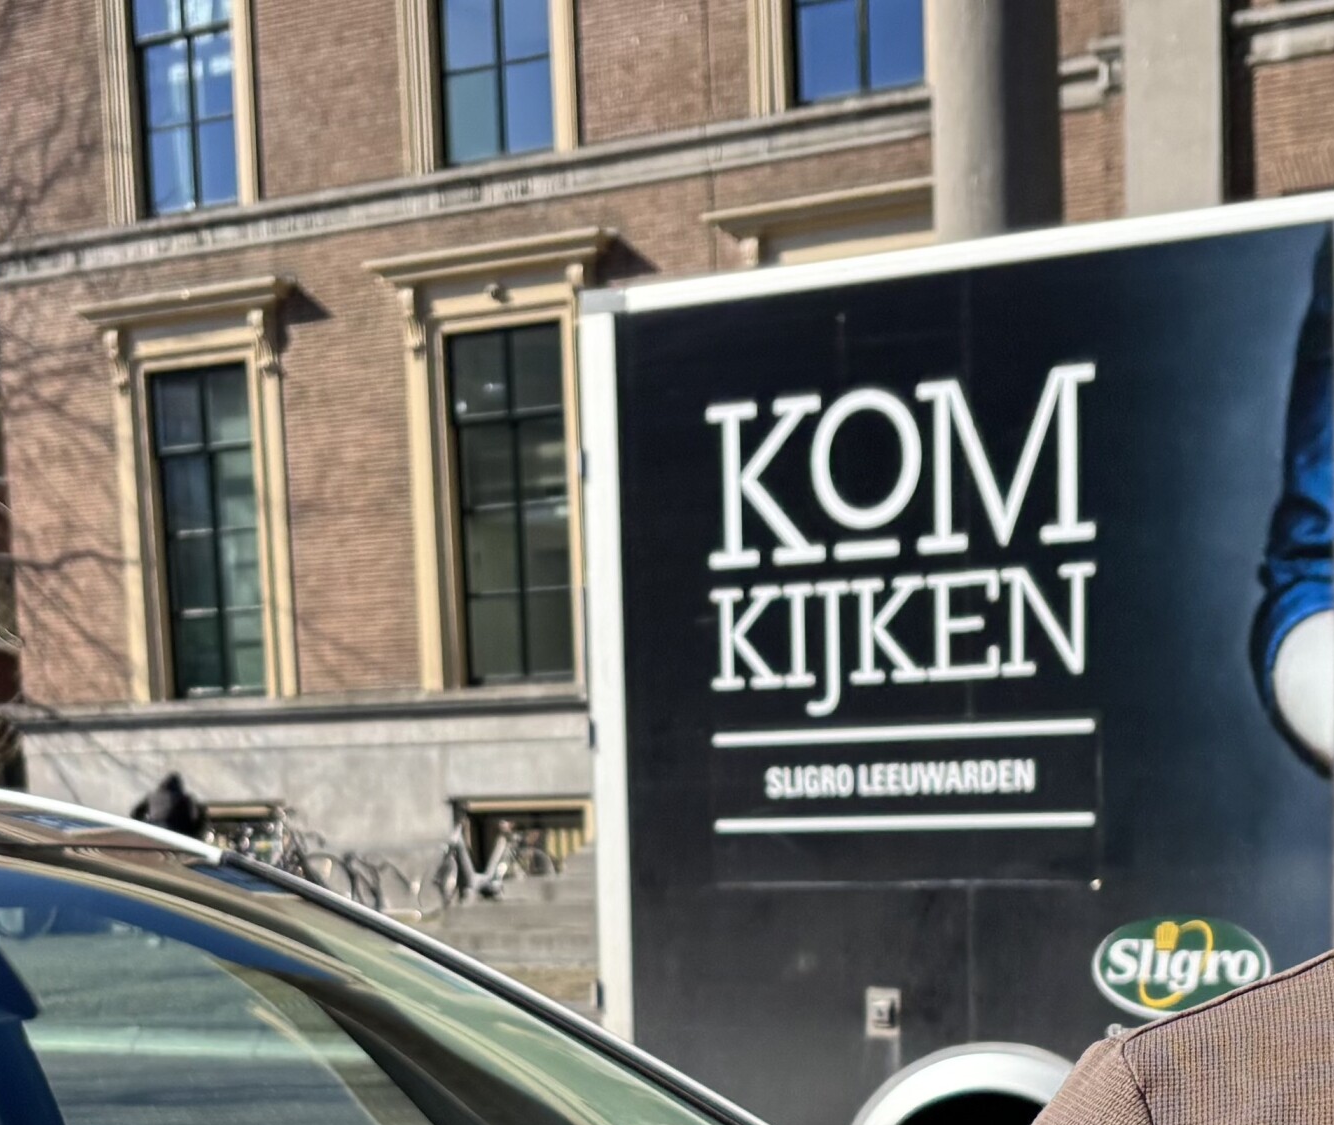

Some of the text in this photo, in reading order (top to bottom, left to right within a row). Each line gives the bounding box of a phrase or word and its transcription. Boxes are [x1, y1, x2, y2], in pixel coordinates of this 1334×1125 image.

[705, 362, 1097, 569] KOM
[710, 562, 1097, 716] KIJKEN
[764, 758, 1036, 799] SLIGRO LEEUWARDEN
[1106, 937, 1260, 996] Sligro
